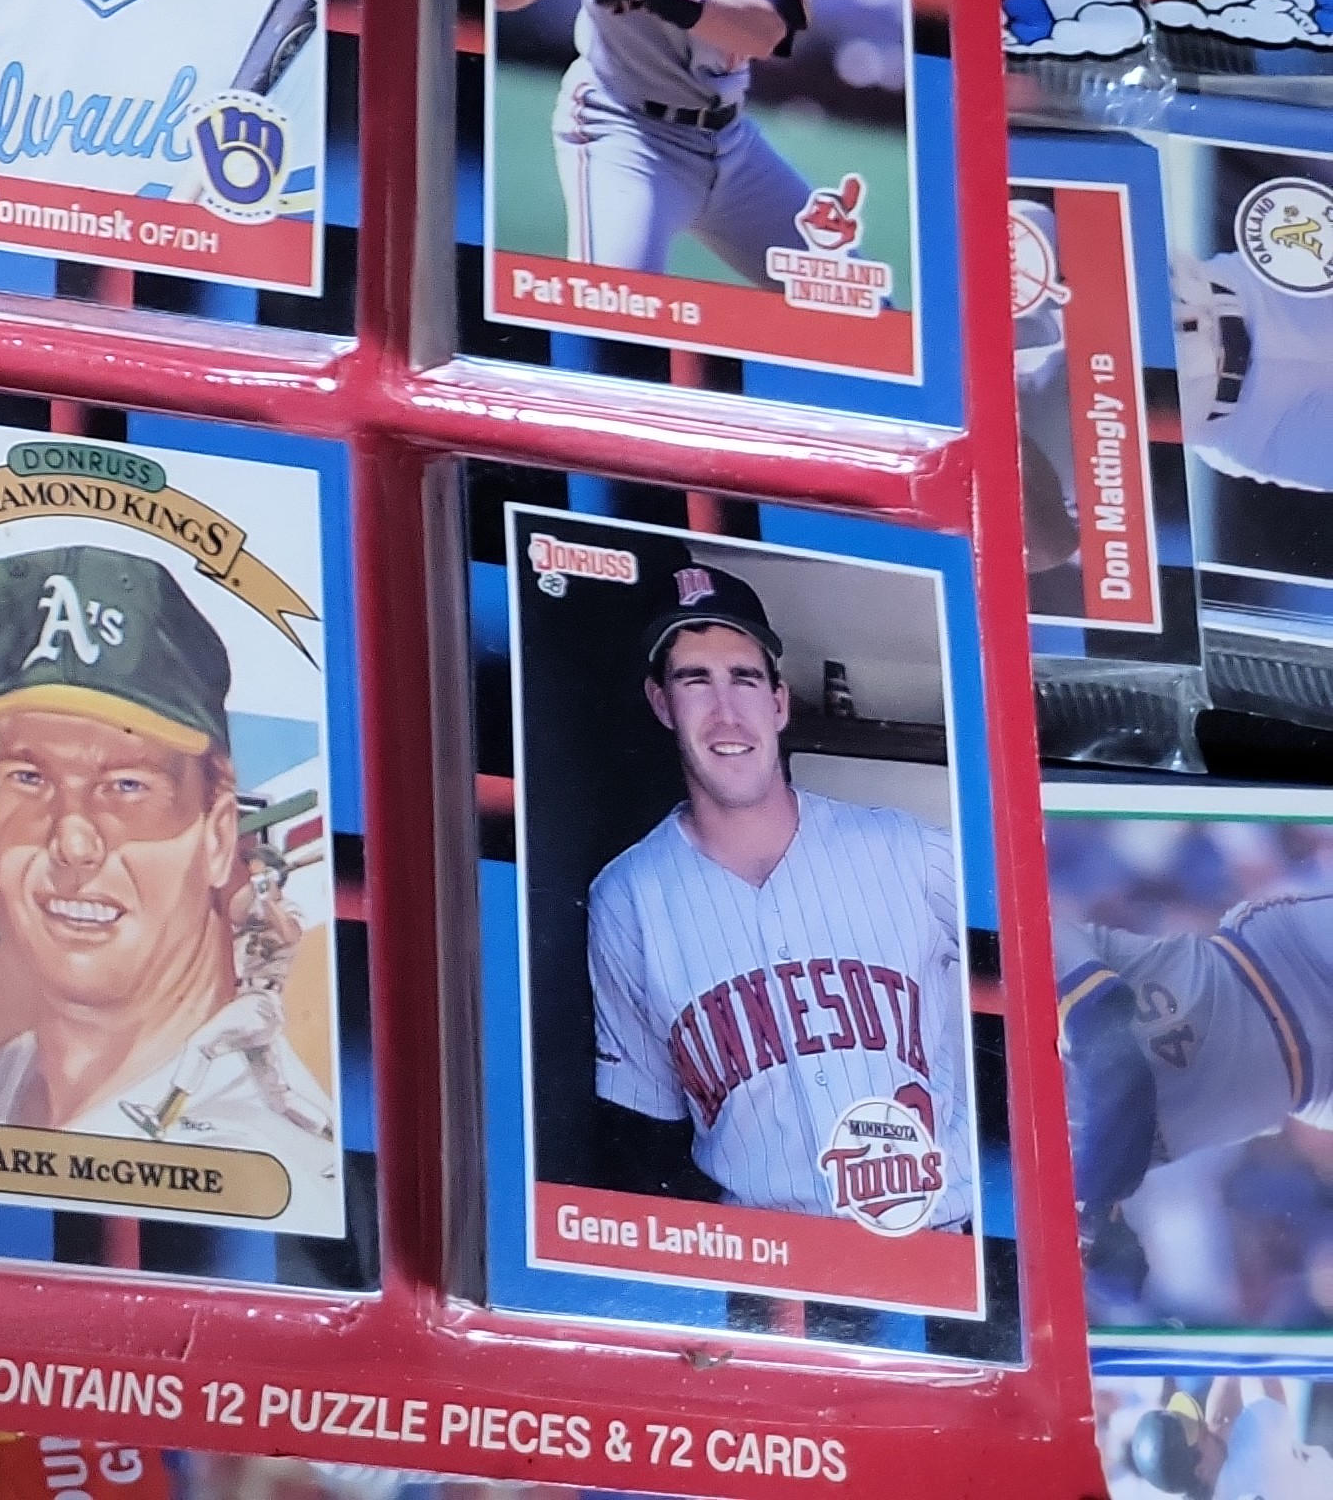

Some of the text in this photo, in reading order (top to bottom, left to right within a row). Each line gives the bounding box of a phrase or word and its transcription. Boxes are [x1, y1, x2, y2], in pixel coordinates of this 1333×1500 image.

[138, 222, 220, 255] OF/DH
[1255, 195, 1277, 265] OAKLAND
[512, 268, 701, 324] Pat Tabler 1B
[774, 253, 886, 287] CLEVELAND
[792, 283, 875, 310] INDIANS
[21, 447, 154, 486] DONRUSS
[1087, 352, 1133, 603] Don Mattingly 1B
[121, 494, 230, 556] KINGS
[531, 537, 636, 582] DONRUSS
[668, 958, 931, 1131] MINNESOTA
[847, 1120, 919, 1142] MINNESOTA
[68, 1155, 224, 1194] McGWIRE
[820, 1145, 943, 1210] Twins
[557, 1204, 789, 1267] Gene Larkin DH
[201, 1382, 245, 1425] 12
[258, 1385, 431, 1444] PUZZLE
[439, 1405, 591, 1460] PIECES
[606, 1425, 637, 1462] &
[644, 1424, 693, 1468] 72
[705, 1429, 847, 1483] CARDS
